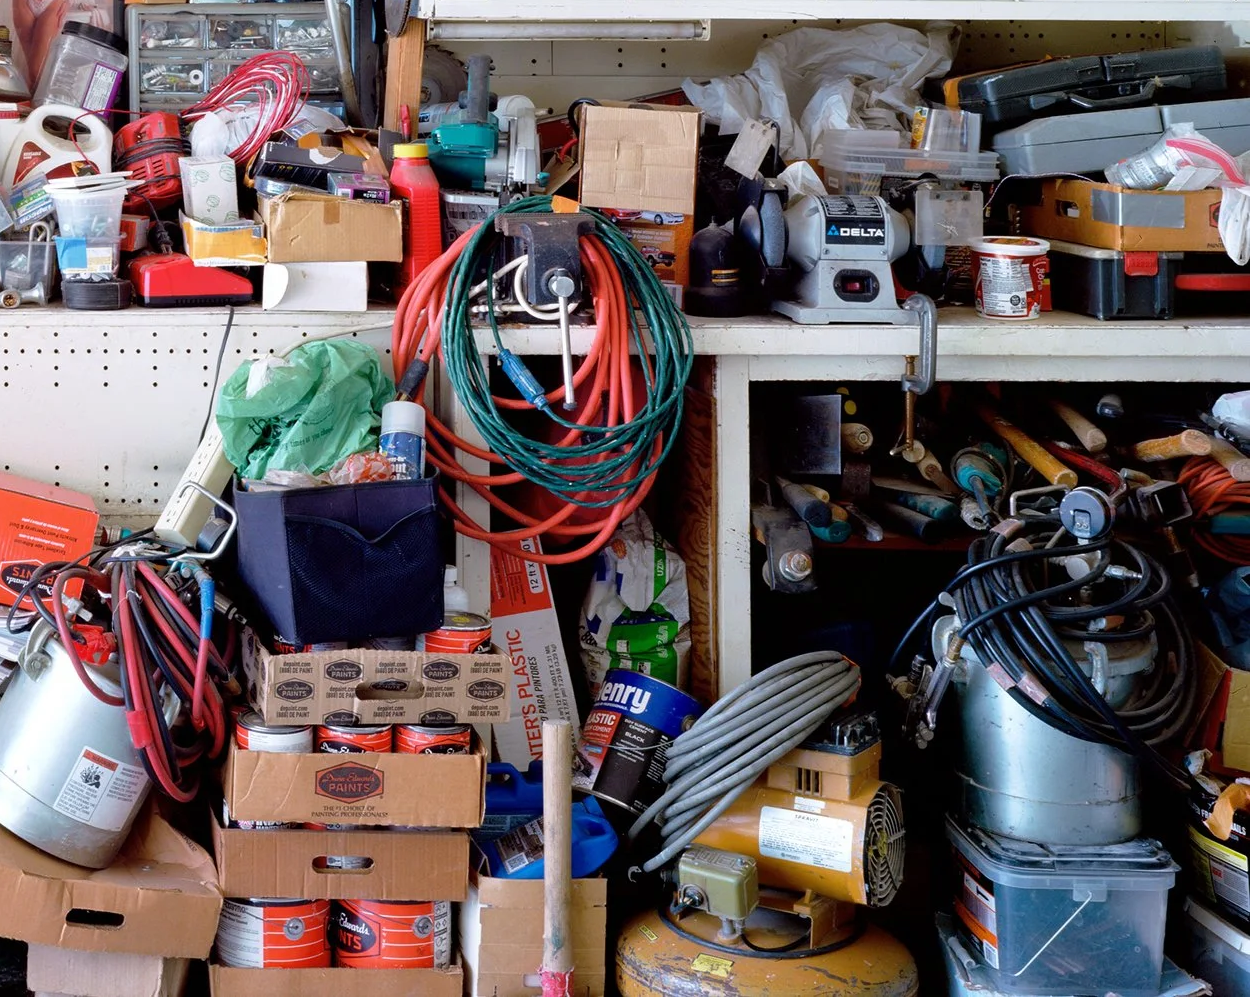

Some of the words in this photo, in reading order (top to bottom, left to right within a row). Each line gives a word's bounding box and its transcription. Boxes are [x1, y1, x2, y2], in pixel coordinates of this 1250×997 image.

[840, 228, 884, 237] DELTA
[11, 567, 54, 585] PNTS
[530, 578, 539, 590] 12
[506, 628, 533, 700] PLASTIC
[528, 656, 544, 693] PINTORES
[536, 692, 548, 715] PARA
[587, 713, 616, 725] ASTIC
[522, 703, 544, 762] NTER'S
[625, 731, 645, 743] BLACK
[328, 783, 371, 793] PAINTS
[339, 913, 370, 935] Edwards
[339, 934, 362, 950] NTS
